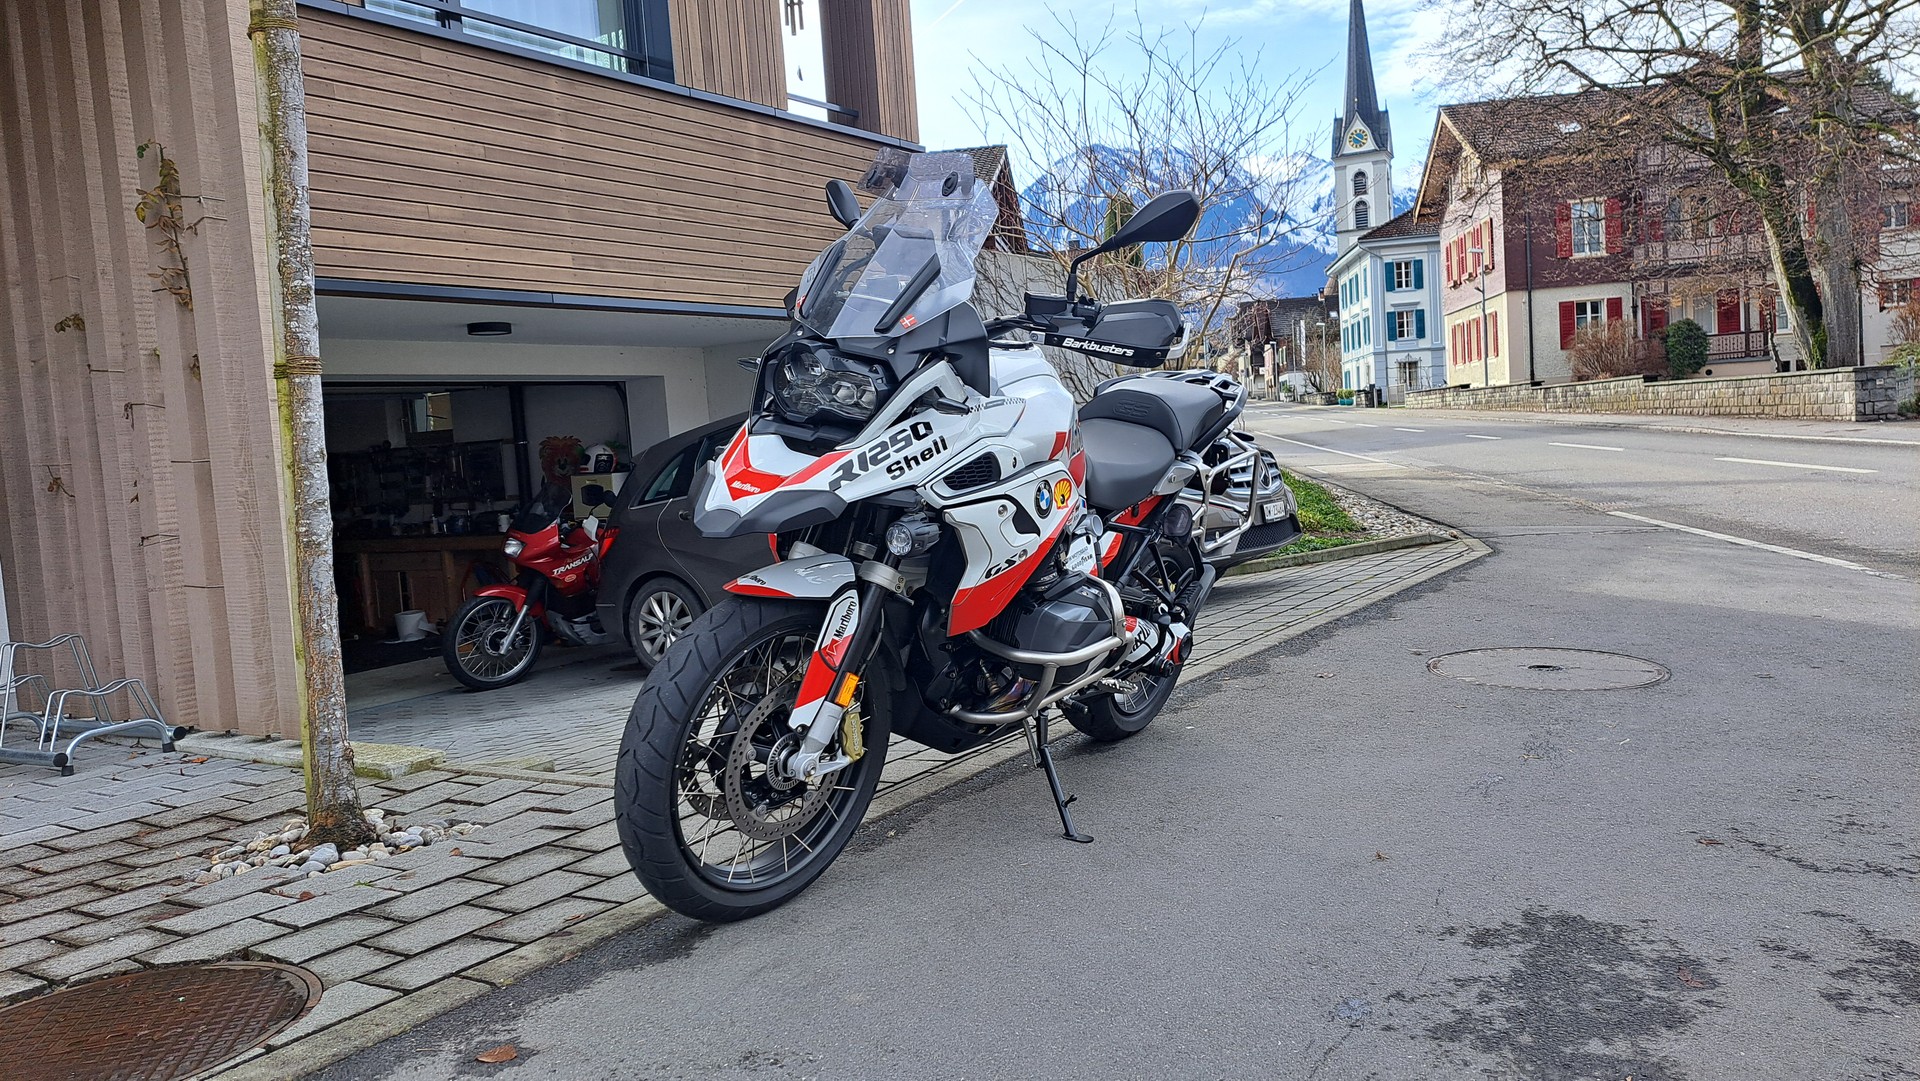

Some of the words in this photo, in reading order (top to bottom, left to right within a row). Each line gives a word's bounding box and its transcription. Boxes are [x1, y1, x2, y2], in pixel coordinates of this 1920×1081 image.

[1062, 336, 1135, 357] Barkbusters
[828, 420, 934, 491] R1250
[886, 435, 949, 481] Shell
[730, 480, 761, 494] Marlboro
[552, 552, 594, 575] TRANSALP
[984, 552, 1019, 579] GS
[833, 600, 858, 640] Marlboro
